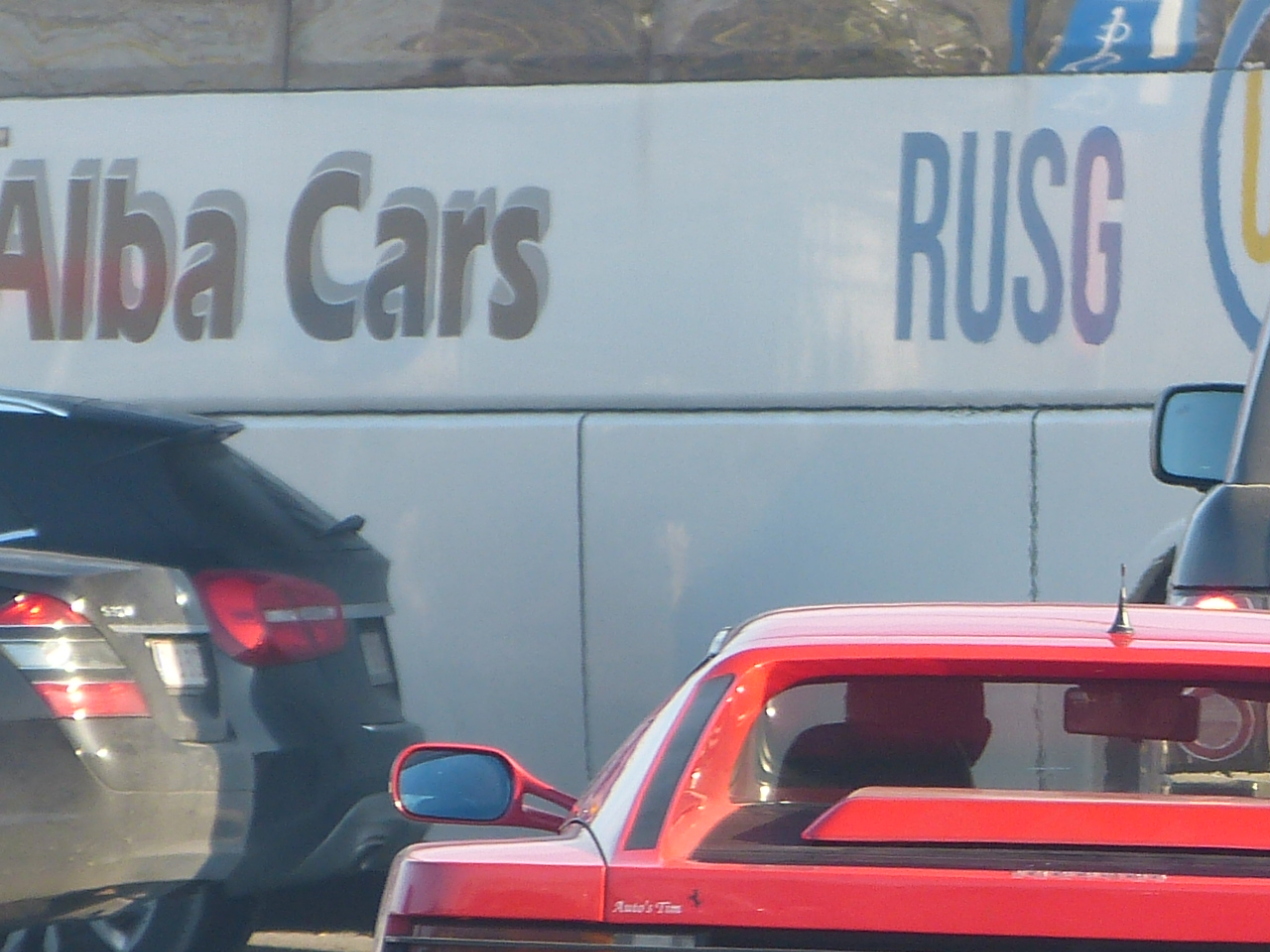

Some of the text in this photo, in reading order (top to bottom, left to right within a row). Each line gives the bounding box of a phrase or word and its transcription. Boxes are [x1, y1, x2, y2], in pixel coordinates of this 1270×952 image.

[0, 150, 549, 342] Alba Cars
[895, 127, 1125, 345] RUSG
[612, 900, 653, 914] Auto's
